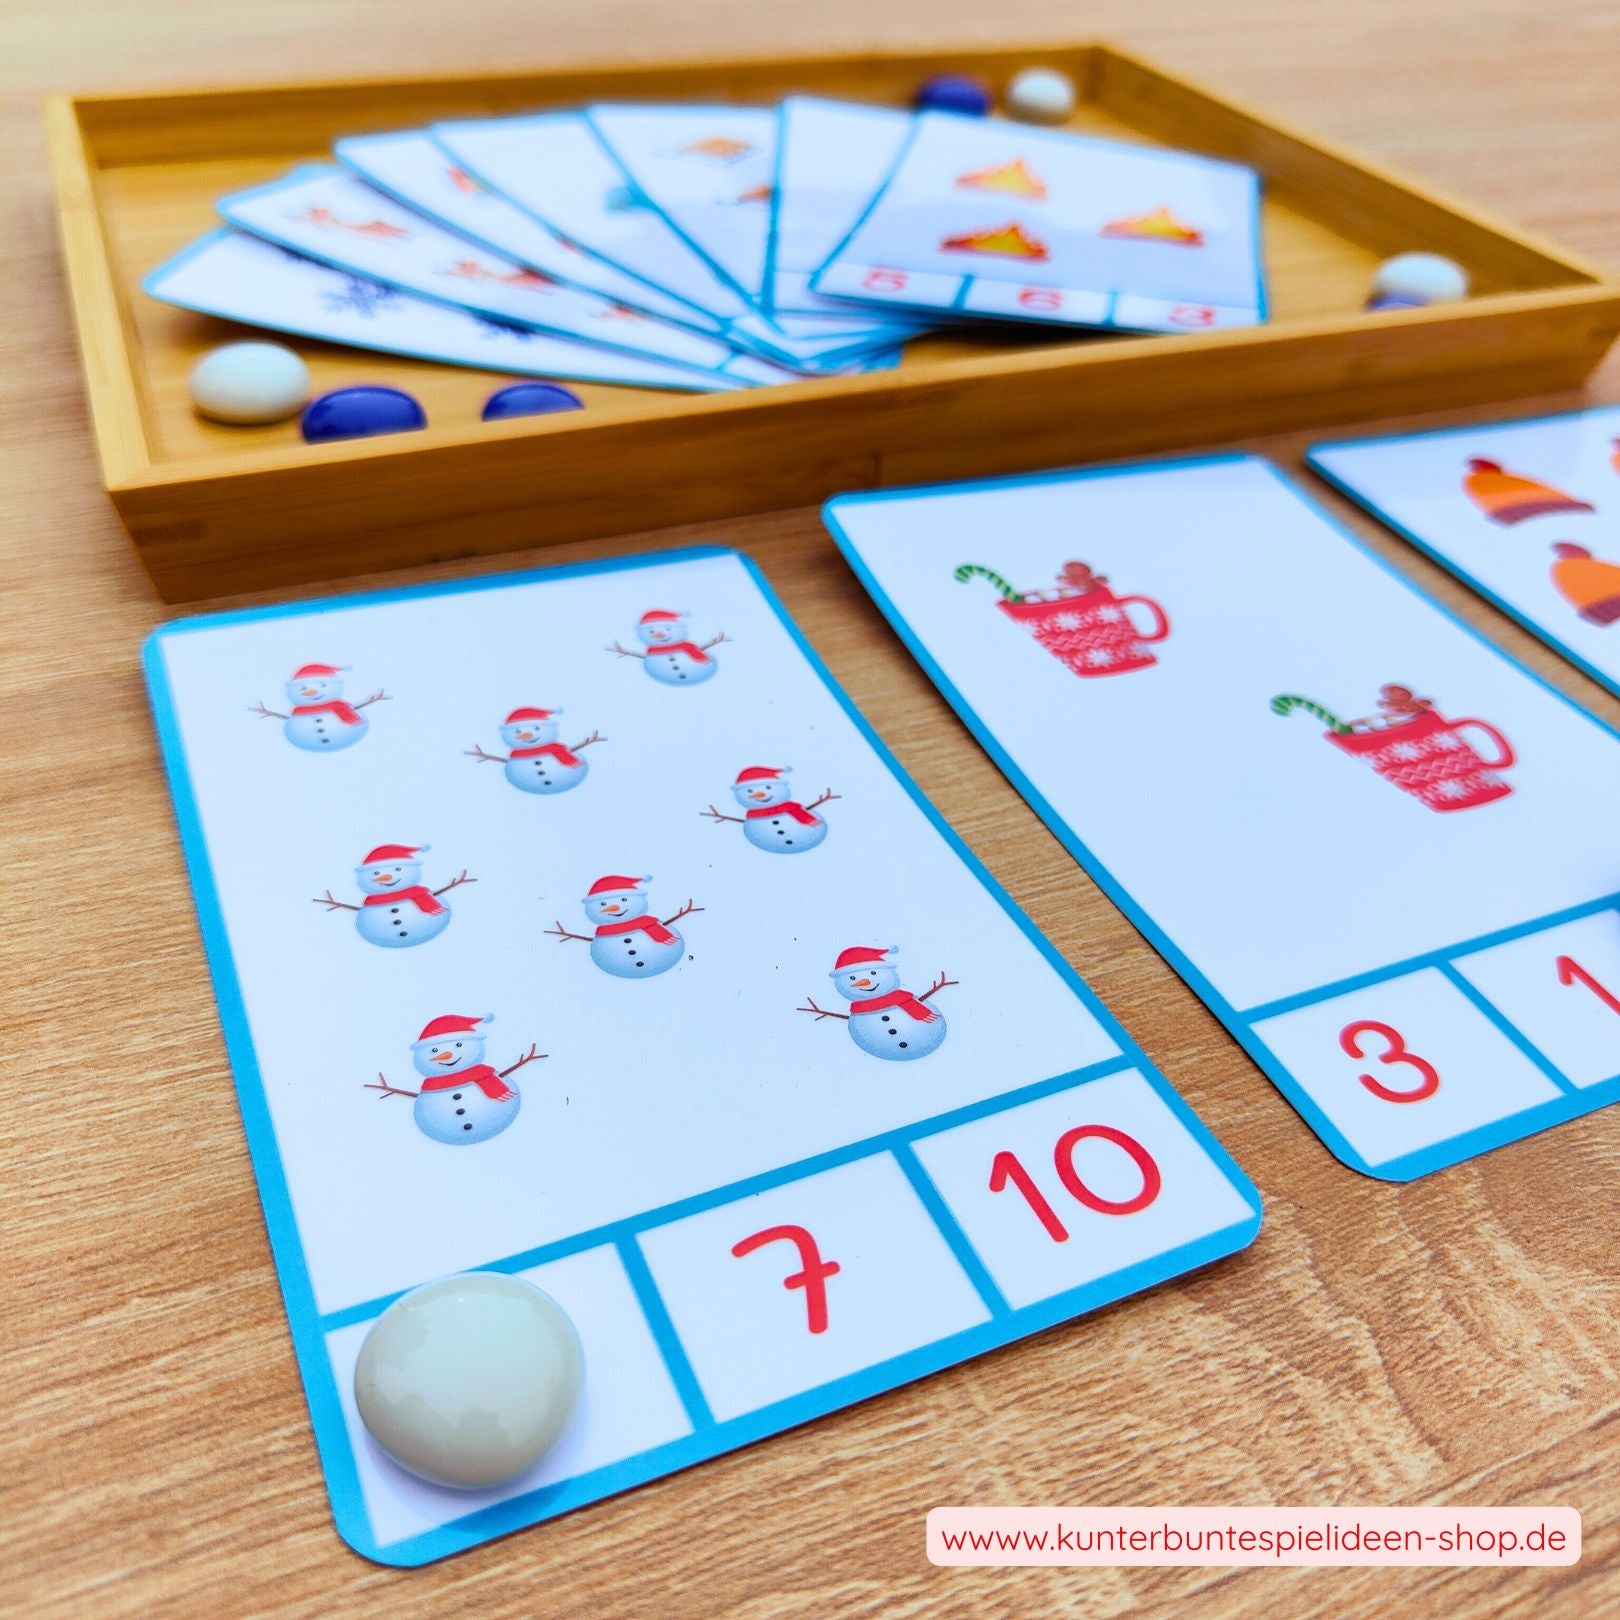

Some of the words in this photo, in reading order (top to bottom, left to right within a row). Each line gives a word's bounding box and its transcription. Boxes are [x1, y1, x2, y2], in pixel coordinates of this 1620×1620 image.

[1339, 1019, 1440, 1104] 3
[731, 1224, 841, 1335] 7
[988, 1123, 1162, 1243] 10
